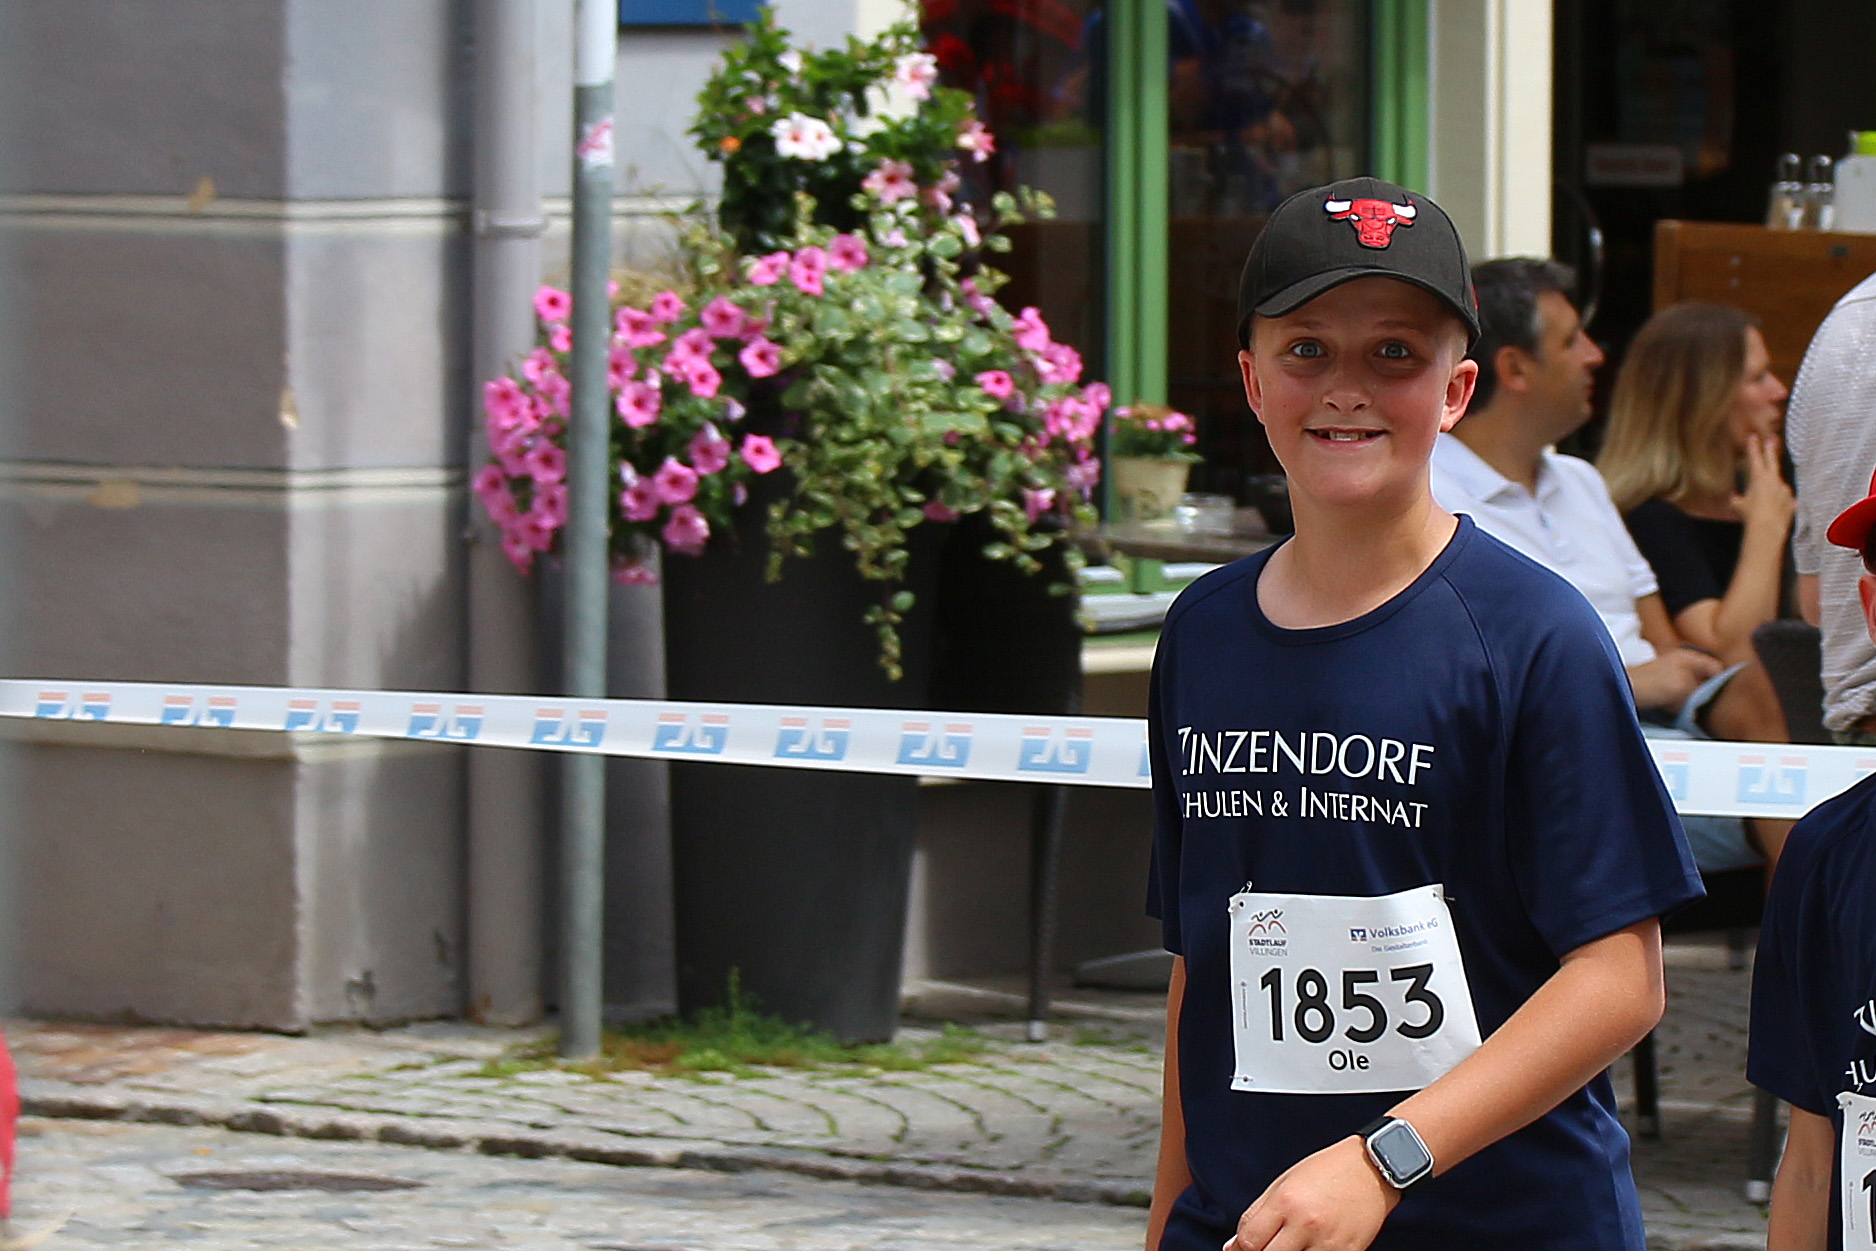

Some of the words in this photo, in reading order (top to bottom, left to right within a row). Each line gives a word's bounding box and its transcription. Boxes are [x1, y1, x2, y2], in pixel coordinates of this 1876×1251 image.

[1182, 789, 1264, 819] HULEN
[1271, 790, 1289, 818] &
[1301, 786, 1429, 828] INTERNAT
[1369, 922, 1426, 939] Volksbank
[1261, 963, 1445, 1044] 1853
[1328, 1050, 1370, 1071] Ole
